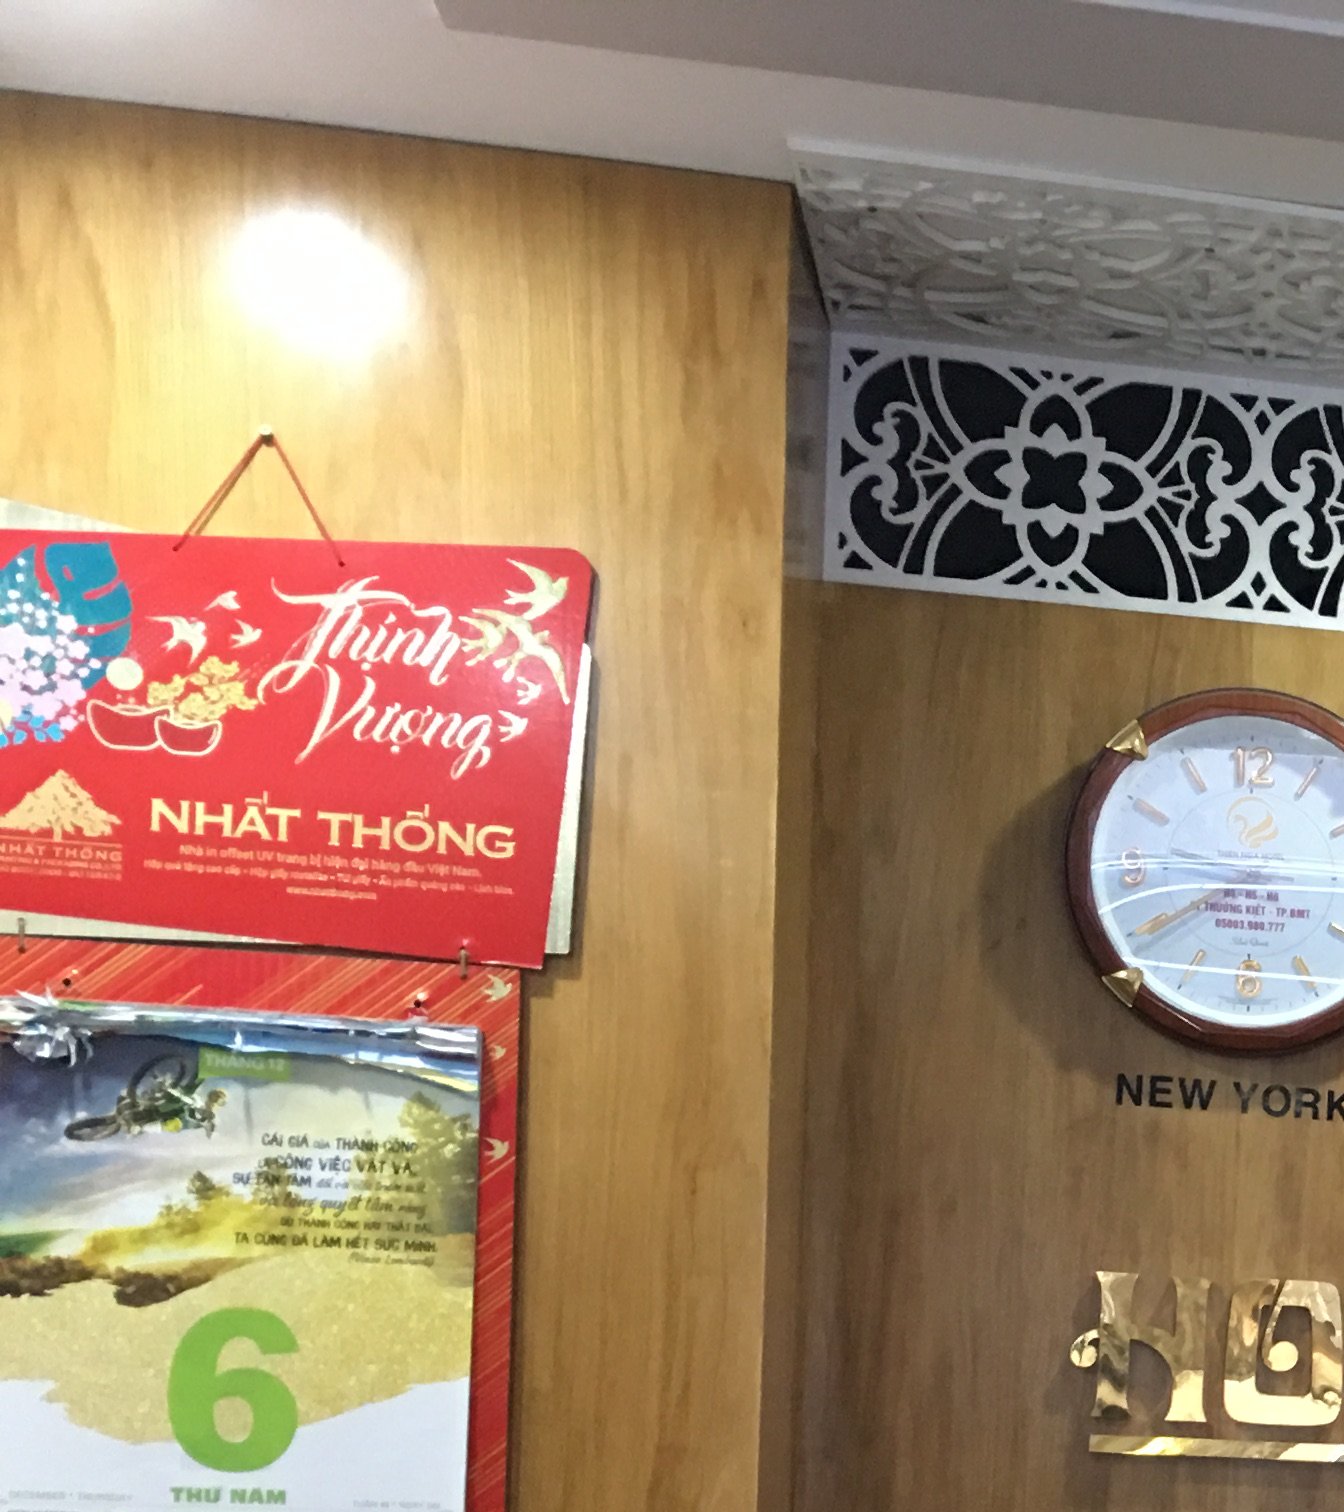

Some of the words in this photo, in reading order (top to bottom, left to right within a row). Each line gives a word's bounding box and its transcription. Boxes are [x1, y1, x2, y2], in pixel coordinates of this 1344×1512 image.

[271, 576, 461, 693] Thịnh
[257, 661, 492, 779] Vượng
[1231, 746, 1275, 788] 12
[150, 791, 301, 842] NHẤT
[316, 803, 516, 859] THỐNG
[1121, 846, 1144, 887] 9
[1235, 958, 1262, 997] 6
[1115, 1072, 1217, 1111] NEW
[167, 1306, 300, 1473] 6
